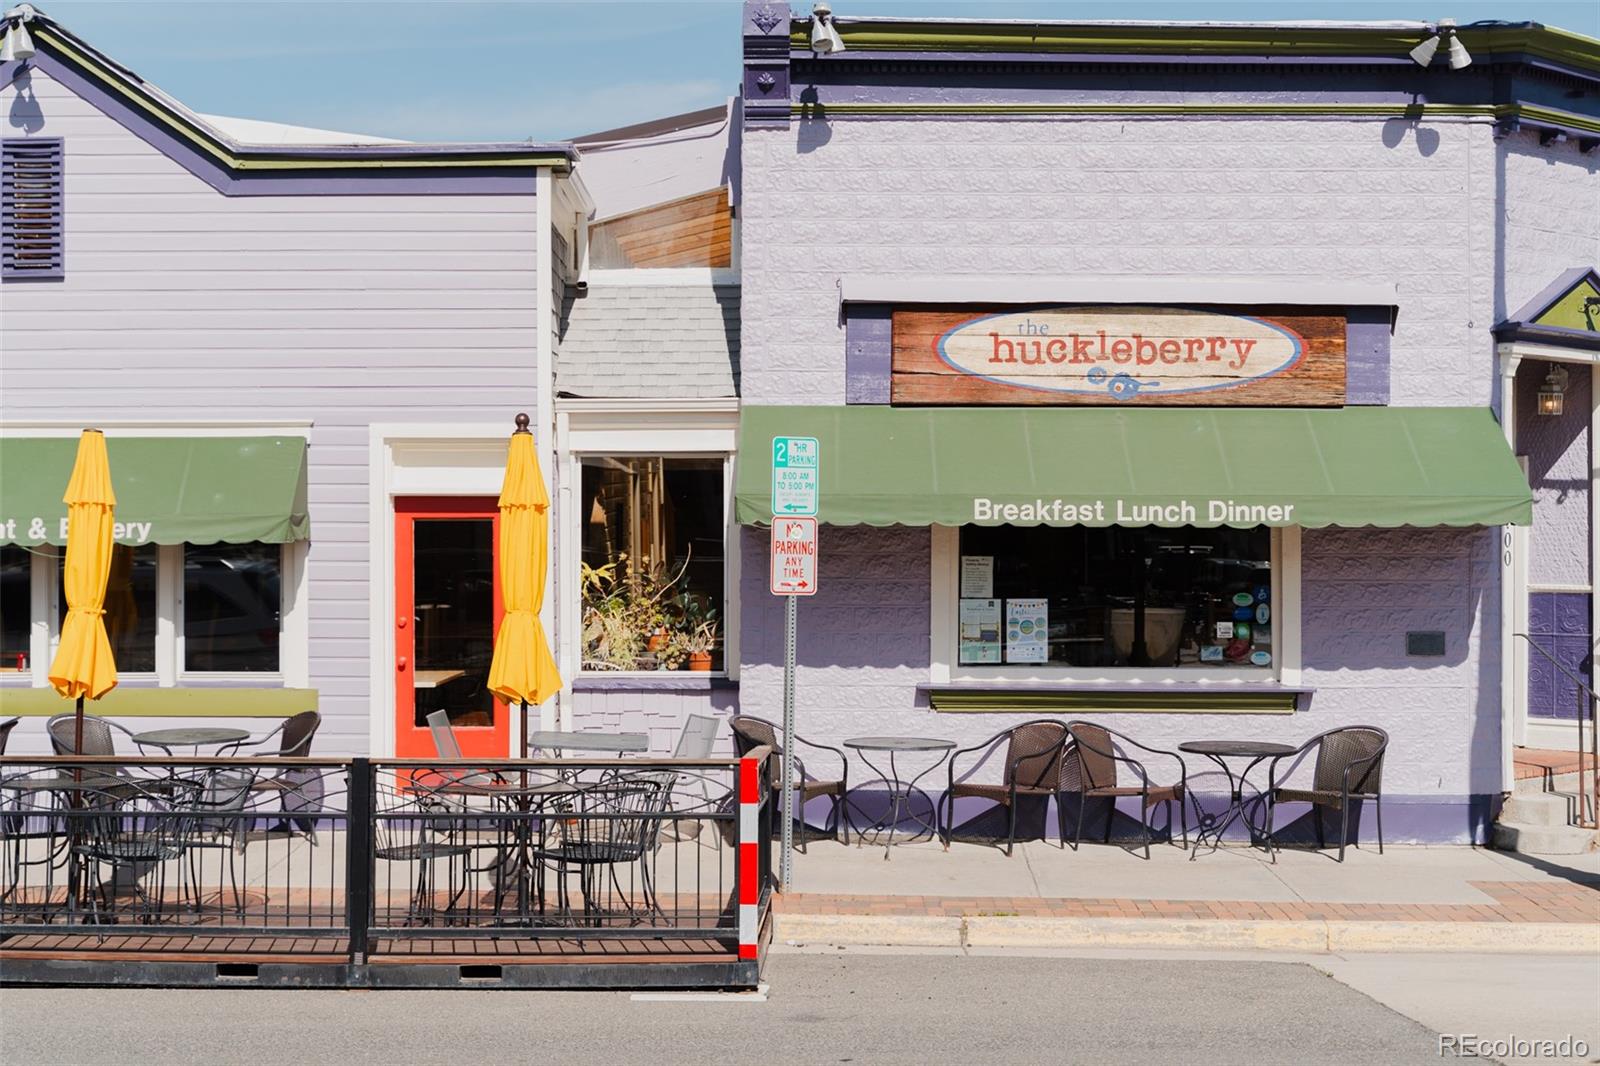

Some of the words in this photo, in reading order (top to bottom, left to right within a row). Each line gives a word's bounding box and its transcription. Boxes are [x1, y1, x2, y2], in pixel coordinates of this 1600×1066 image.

[1017, 319, 1049, 336] the
[988, 330, 1258, 370] huckleberry
[776, 442, 787, 462] 2
[796, 443, 808, 453] HR
[788, 455, 815, 465] PARKING
[799, 472, 810, 480] AM
[777, 481, 786, 490] TO
[804, 482, 815, 491] PM
[973, 498, 1105, 522] Breakfast
[1116, 499, 1196, 523] Lunch
[1207, 499, 1295, 523] Dinner
[28, 517, 47, 540] &
[775, 540, 814, 555] PARKING
[785, 557, 804, 567] ANY
[783, 568, 805, 578] TIME
